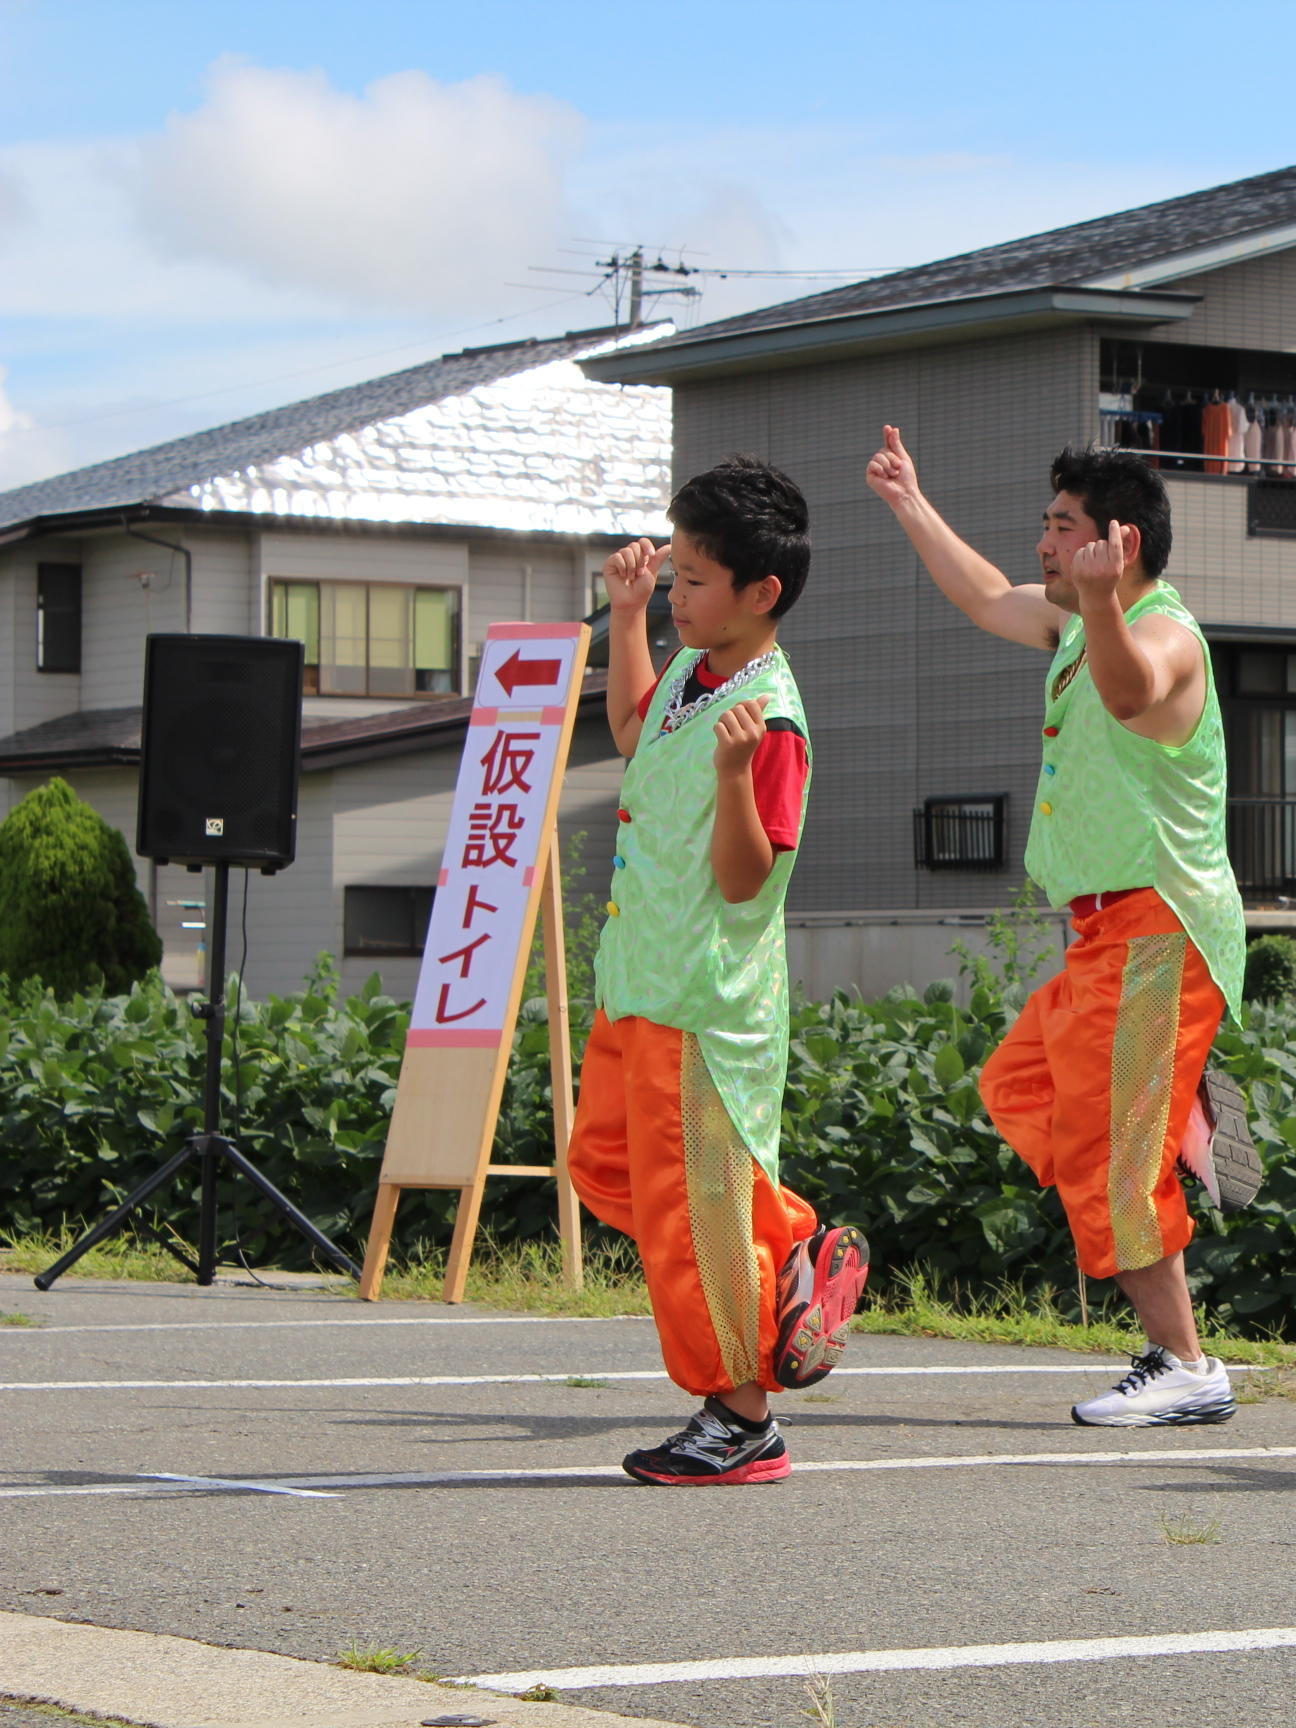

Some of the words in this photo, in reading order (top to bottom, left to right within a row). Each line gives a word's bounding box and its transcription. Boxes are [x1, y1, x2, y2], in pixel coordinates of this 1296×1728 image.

[436, 729, 541, 1025] 仮設トイレ
